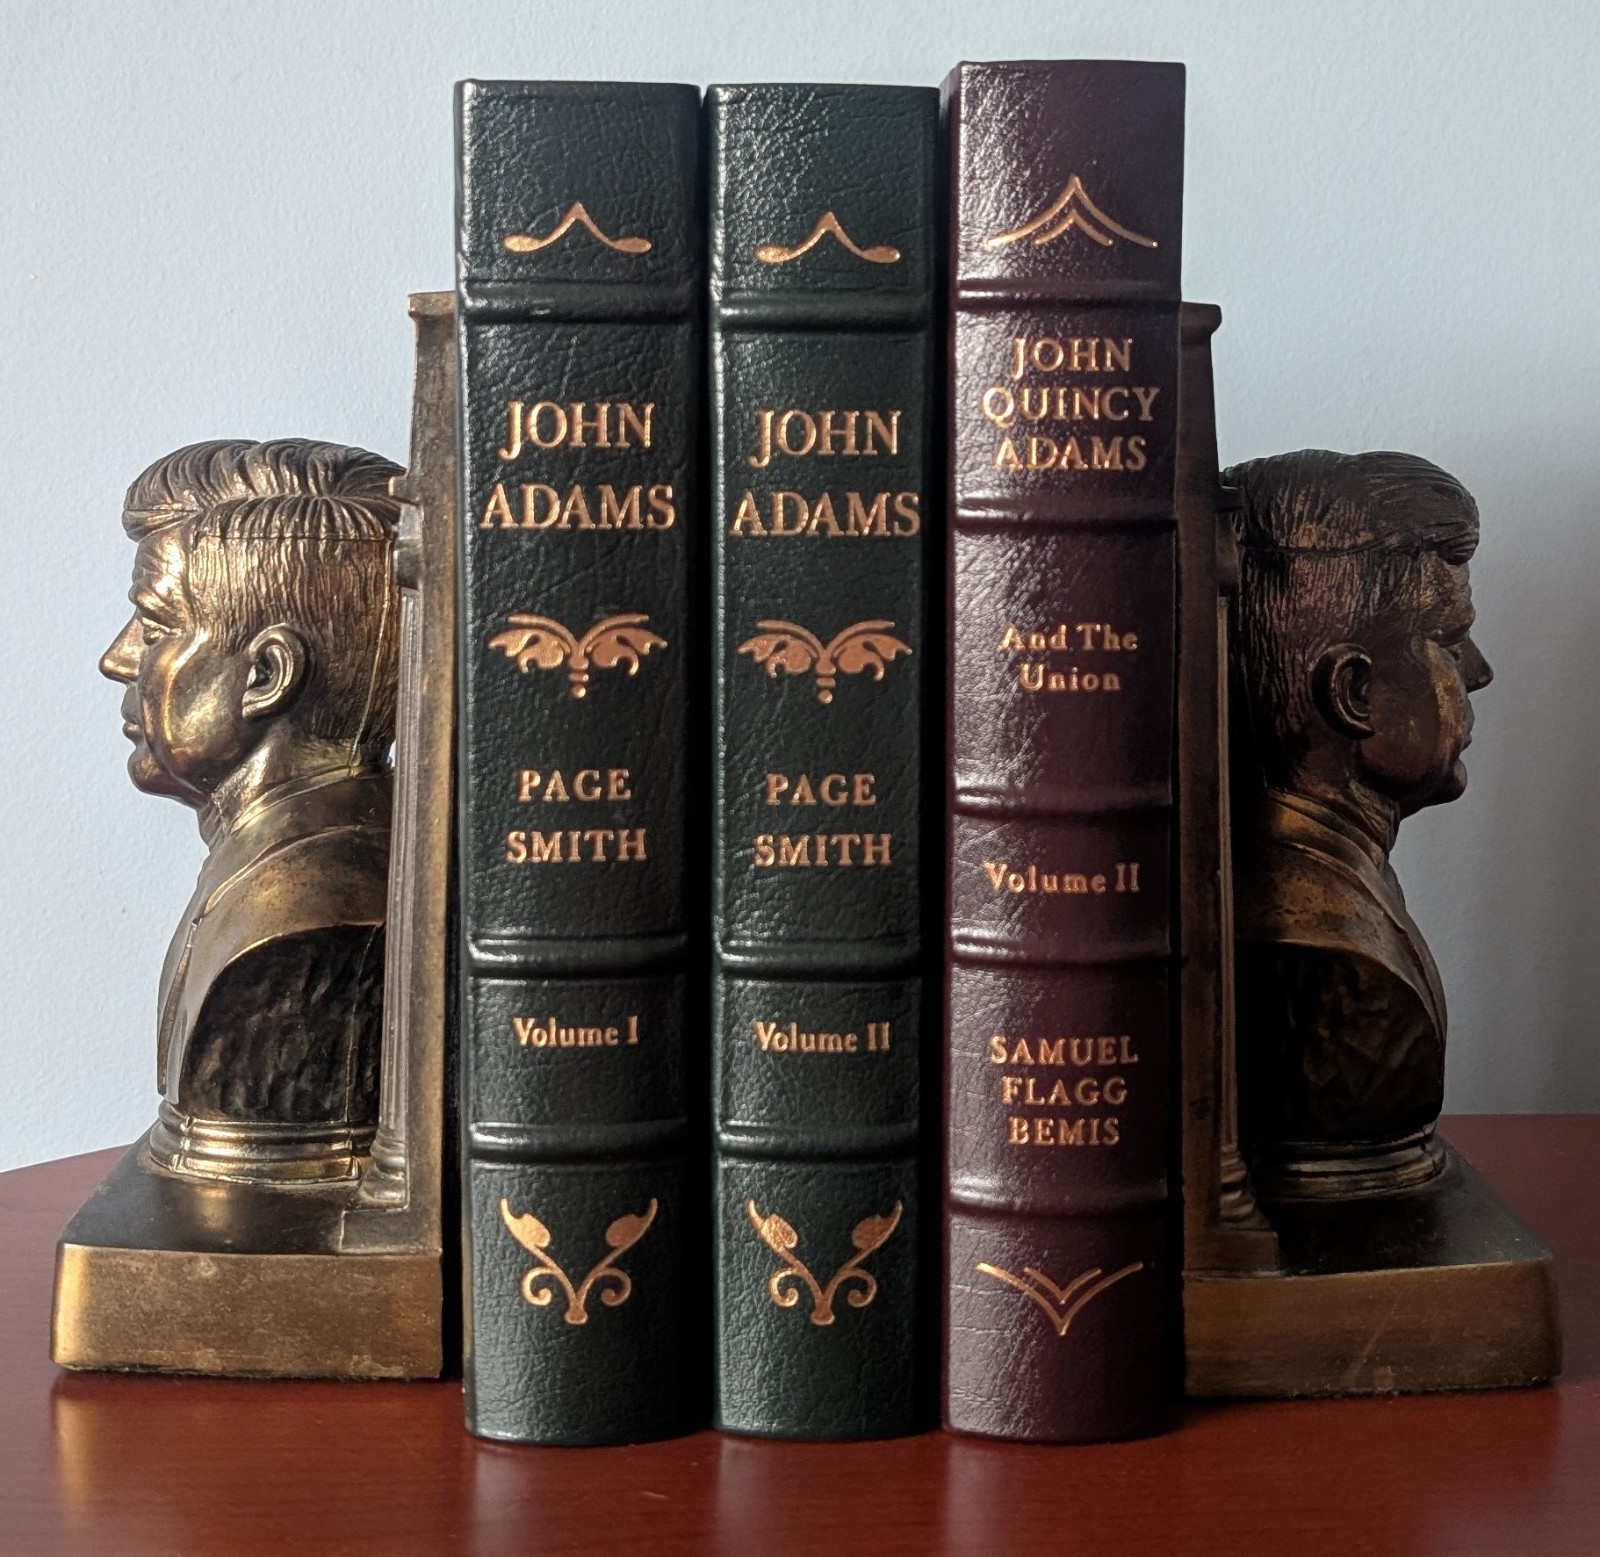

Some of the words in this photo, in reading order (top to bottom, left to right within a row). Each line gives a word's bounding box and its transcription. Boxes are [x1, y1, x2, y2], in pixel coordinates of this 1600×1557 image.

[1011, 336, 1133, 381] JOHN
[980, 385, 1160, 429] QUINCY
[499, 400, 656, 462] JOHN
[747, 408, 902, 469] JOHN
[991, 434, 1149, 472] ADAMS
[479, 482, 677, 530] ADAMS
[729, 490, 921, 537] ADAMS
[997, 622, 1068, 651] And
[1075, 622, 1139, 651] The
[1019, 661, 1121, 692] Union
[517, 768, 632, 802] PAGE
[766, 773, 878, 806] PAGE
[505, 828, 648, 864] SMITH
[754, 832, 892, 867] SMITH
[983, 860, 1107, 894] Volume
[1114, 862, 1140, 893] II
[512, 1015, 619, 1048] Volume
[625, 1014, 639, 1046] I
[755, 1019, 858, 1054] Volume
[865, 1020, 891, 1052] II
[988, 1033, 1139, 1067] SAMUEL
[1001, 1075, 1128, 1107] FLAGG
[1008, 1115, 1120, 1147] BEMIS
